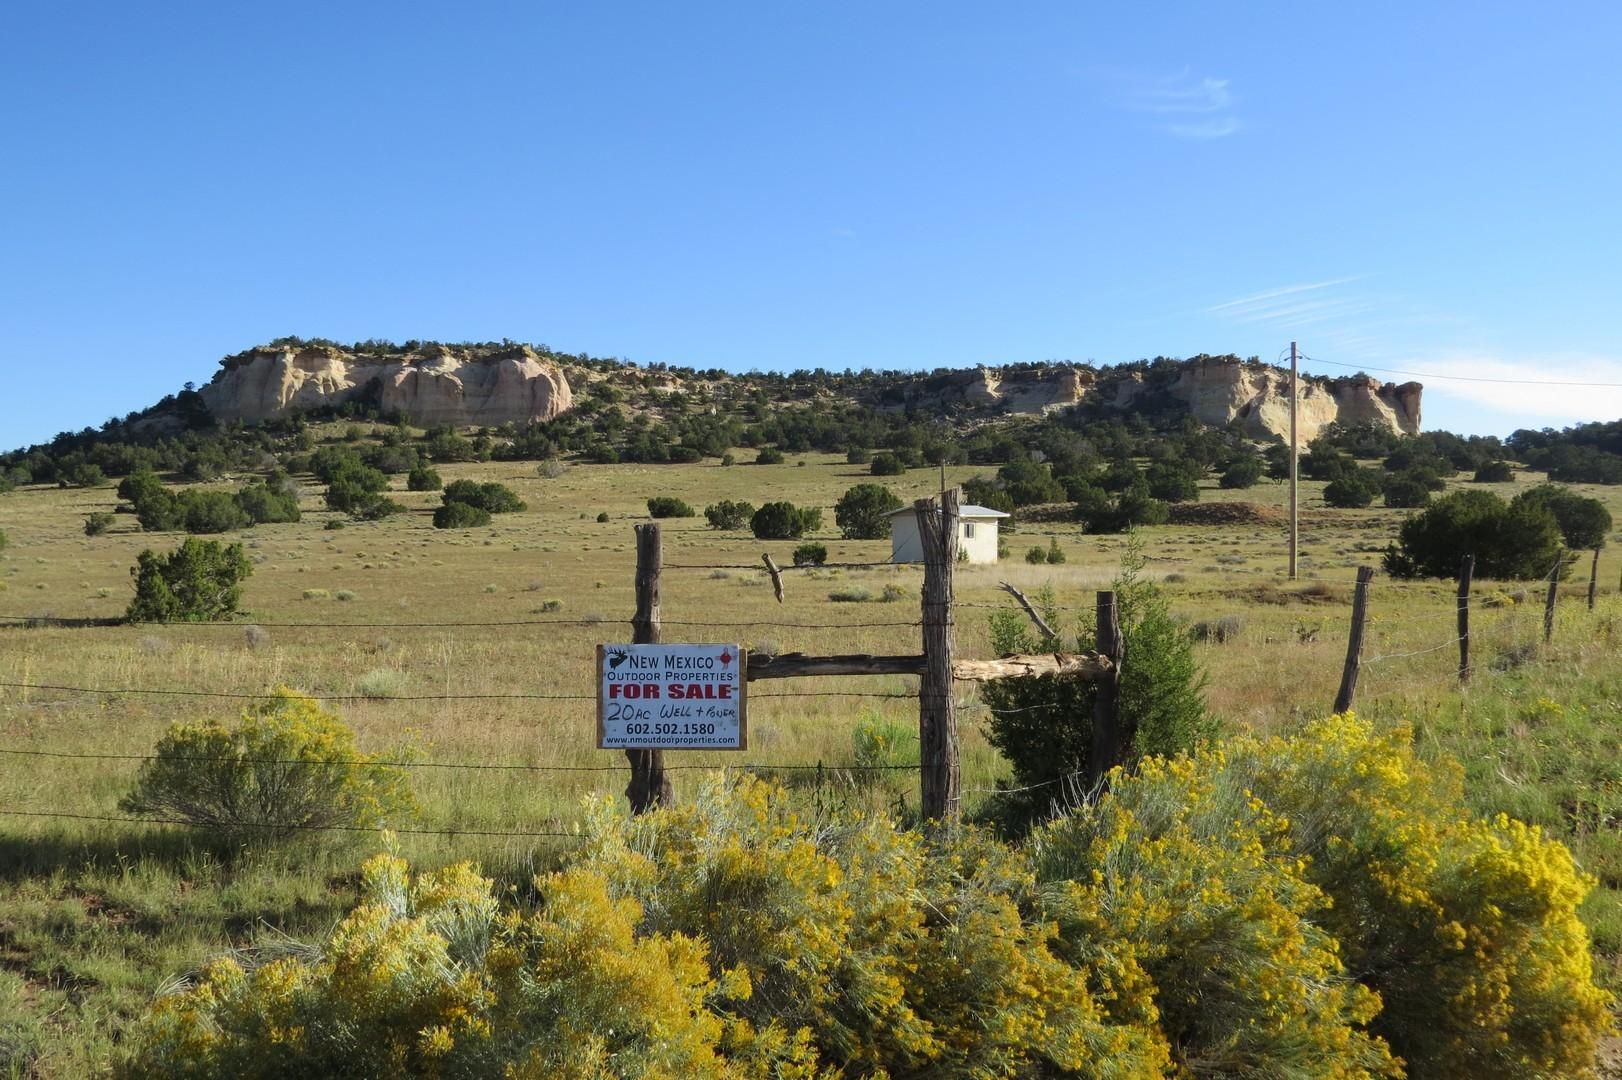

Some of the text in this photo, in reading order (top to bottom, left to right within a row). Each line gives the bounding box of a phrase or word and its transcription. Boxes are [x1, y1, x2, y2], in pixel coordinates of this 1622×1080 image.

[629, 655, 714, 670] NEW MEXICO
[607, 671, 733, 681] OUTDOOR PROPERTIES
[609, 683, 732, 699] FOR SALE
[626, 723, 715, 735] 602.502.1580
[606, 735, 736, 745] www.nmoutdoorproperties.com
